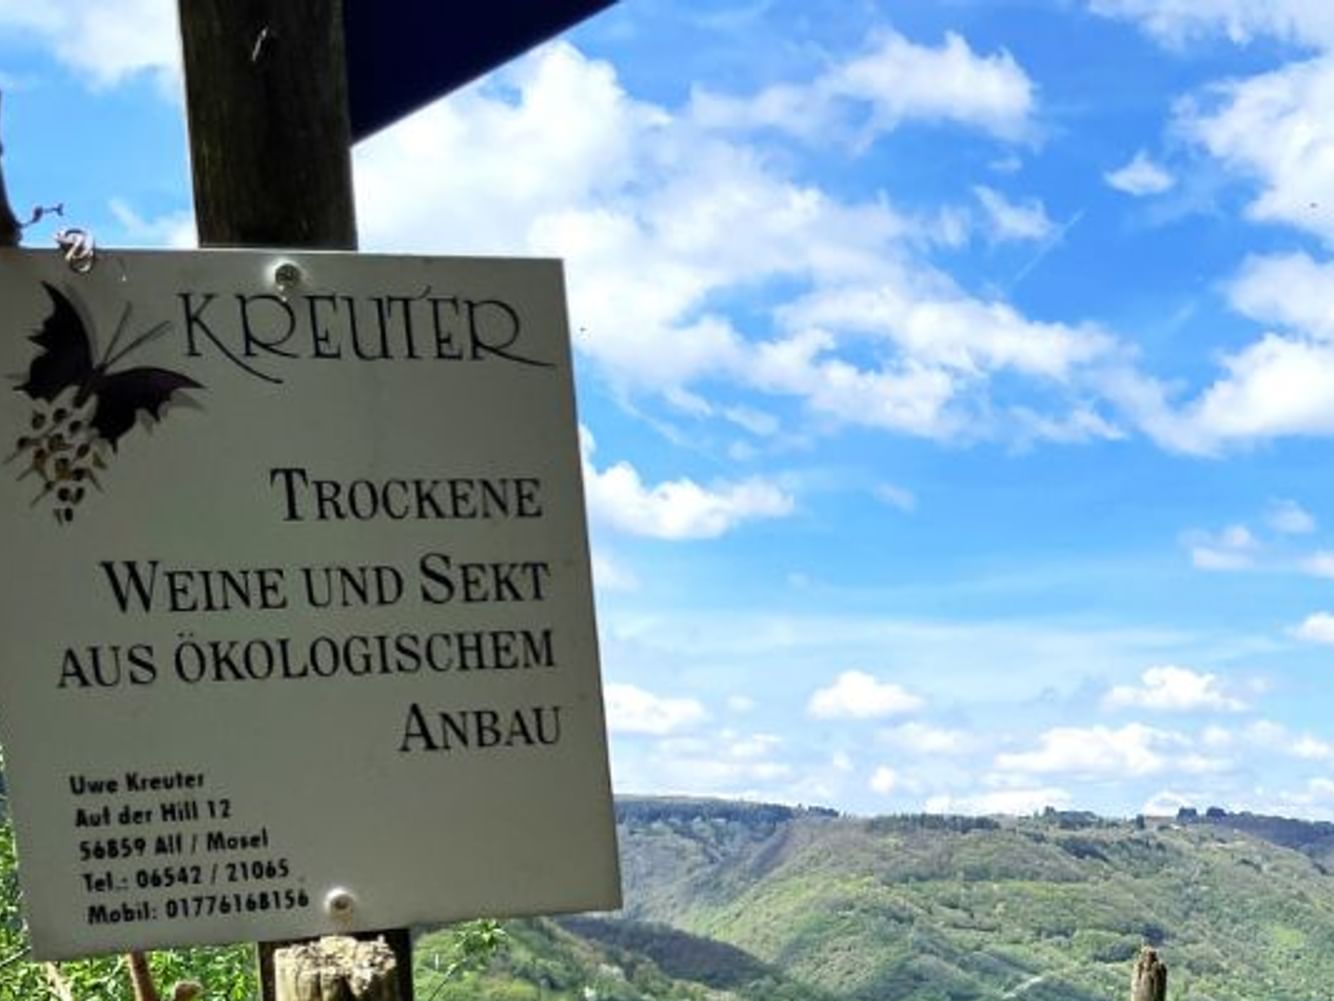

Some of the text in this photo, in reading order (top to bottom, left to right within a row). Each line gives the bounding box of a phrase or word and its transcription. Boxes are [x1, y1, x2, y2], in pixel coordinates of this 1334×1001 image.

[178, 285, 555, 384] KREUTER
[270, 467, 543, 521] TROCKENE
[101, 553, 549, 613] WEINE UND SEKT
[57, 630, 555, 689] AUS ÖKOLOGISCHEM
[400, 702, 562, 753] ANBAU
[70, 772, 204, 794] Uwe Kreuter
[75, 799, 233, 828] Auf der Hill 12
[80, 826, 269, 861] 56859 Alf / Mosel
[82, 858, 290, 893] Tel.: 06542 / 21065
[88, 889, 310, 925] Mobil: 01776168156
